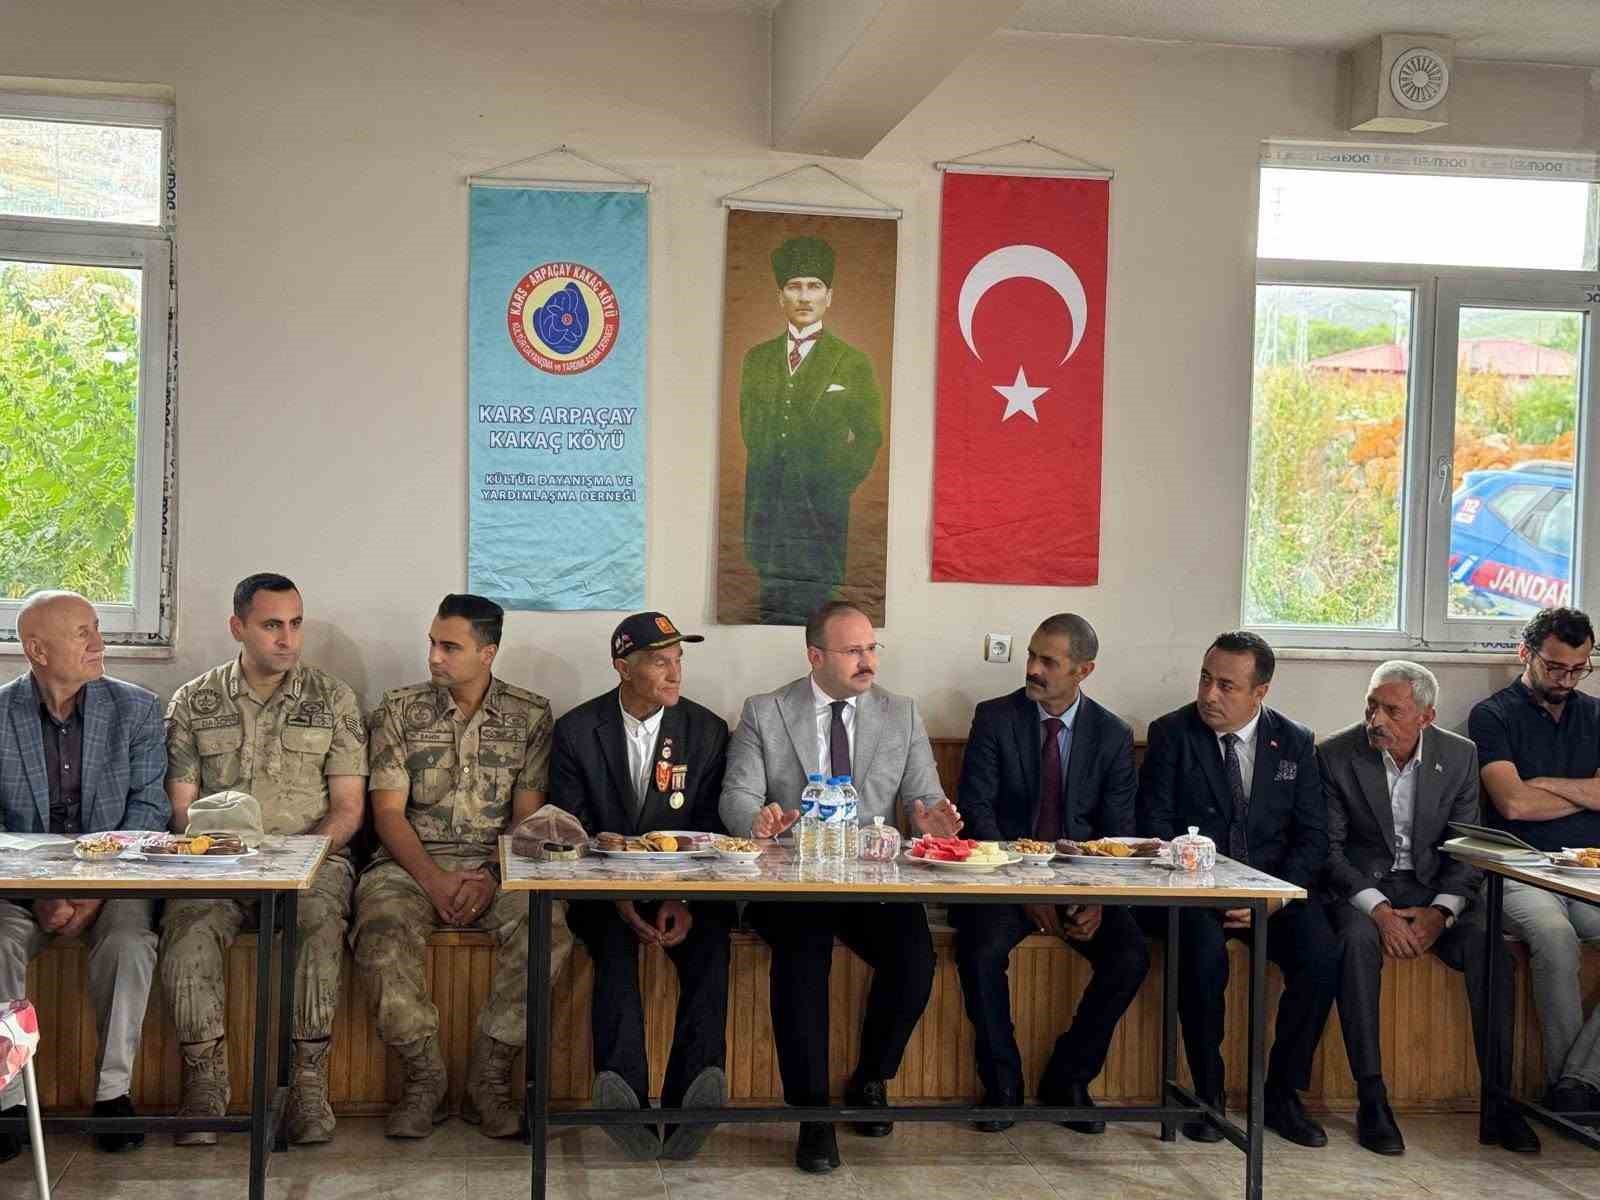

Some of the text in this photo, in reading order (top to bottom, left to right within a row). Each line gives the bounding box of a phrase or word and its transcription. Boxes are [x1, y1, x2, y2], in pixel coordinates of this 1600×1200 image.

[510, 287, 528, 316] KARS
[529, 263, 572, 286] ARPAÇAY
[598, 289, 618, 318] KÖYÜ
[479, 404, 636, 429] KARS ARPAÇAY
[489, 429, 625, 454] KAKAÇ KÖYÜ
[484, 471, 633, 487] KÜLTÜR DAYANIŞMA VE
[480, 489, 637, 503] YARDIMLAŞMA DERNEĞİ
